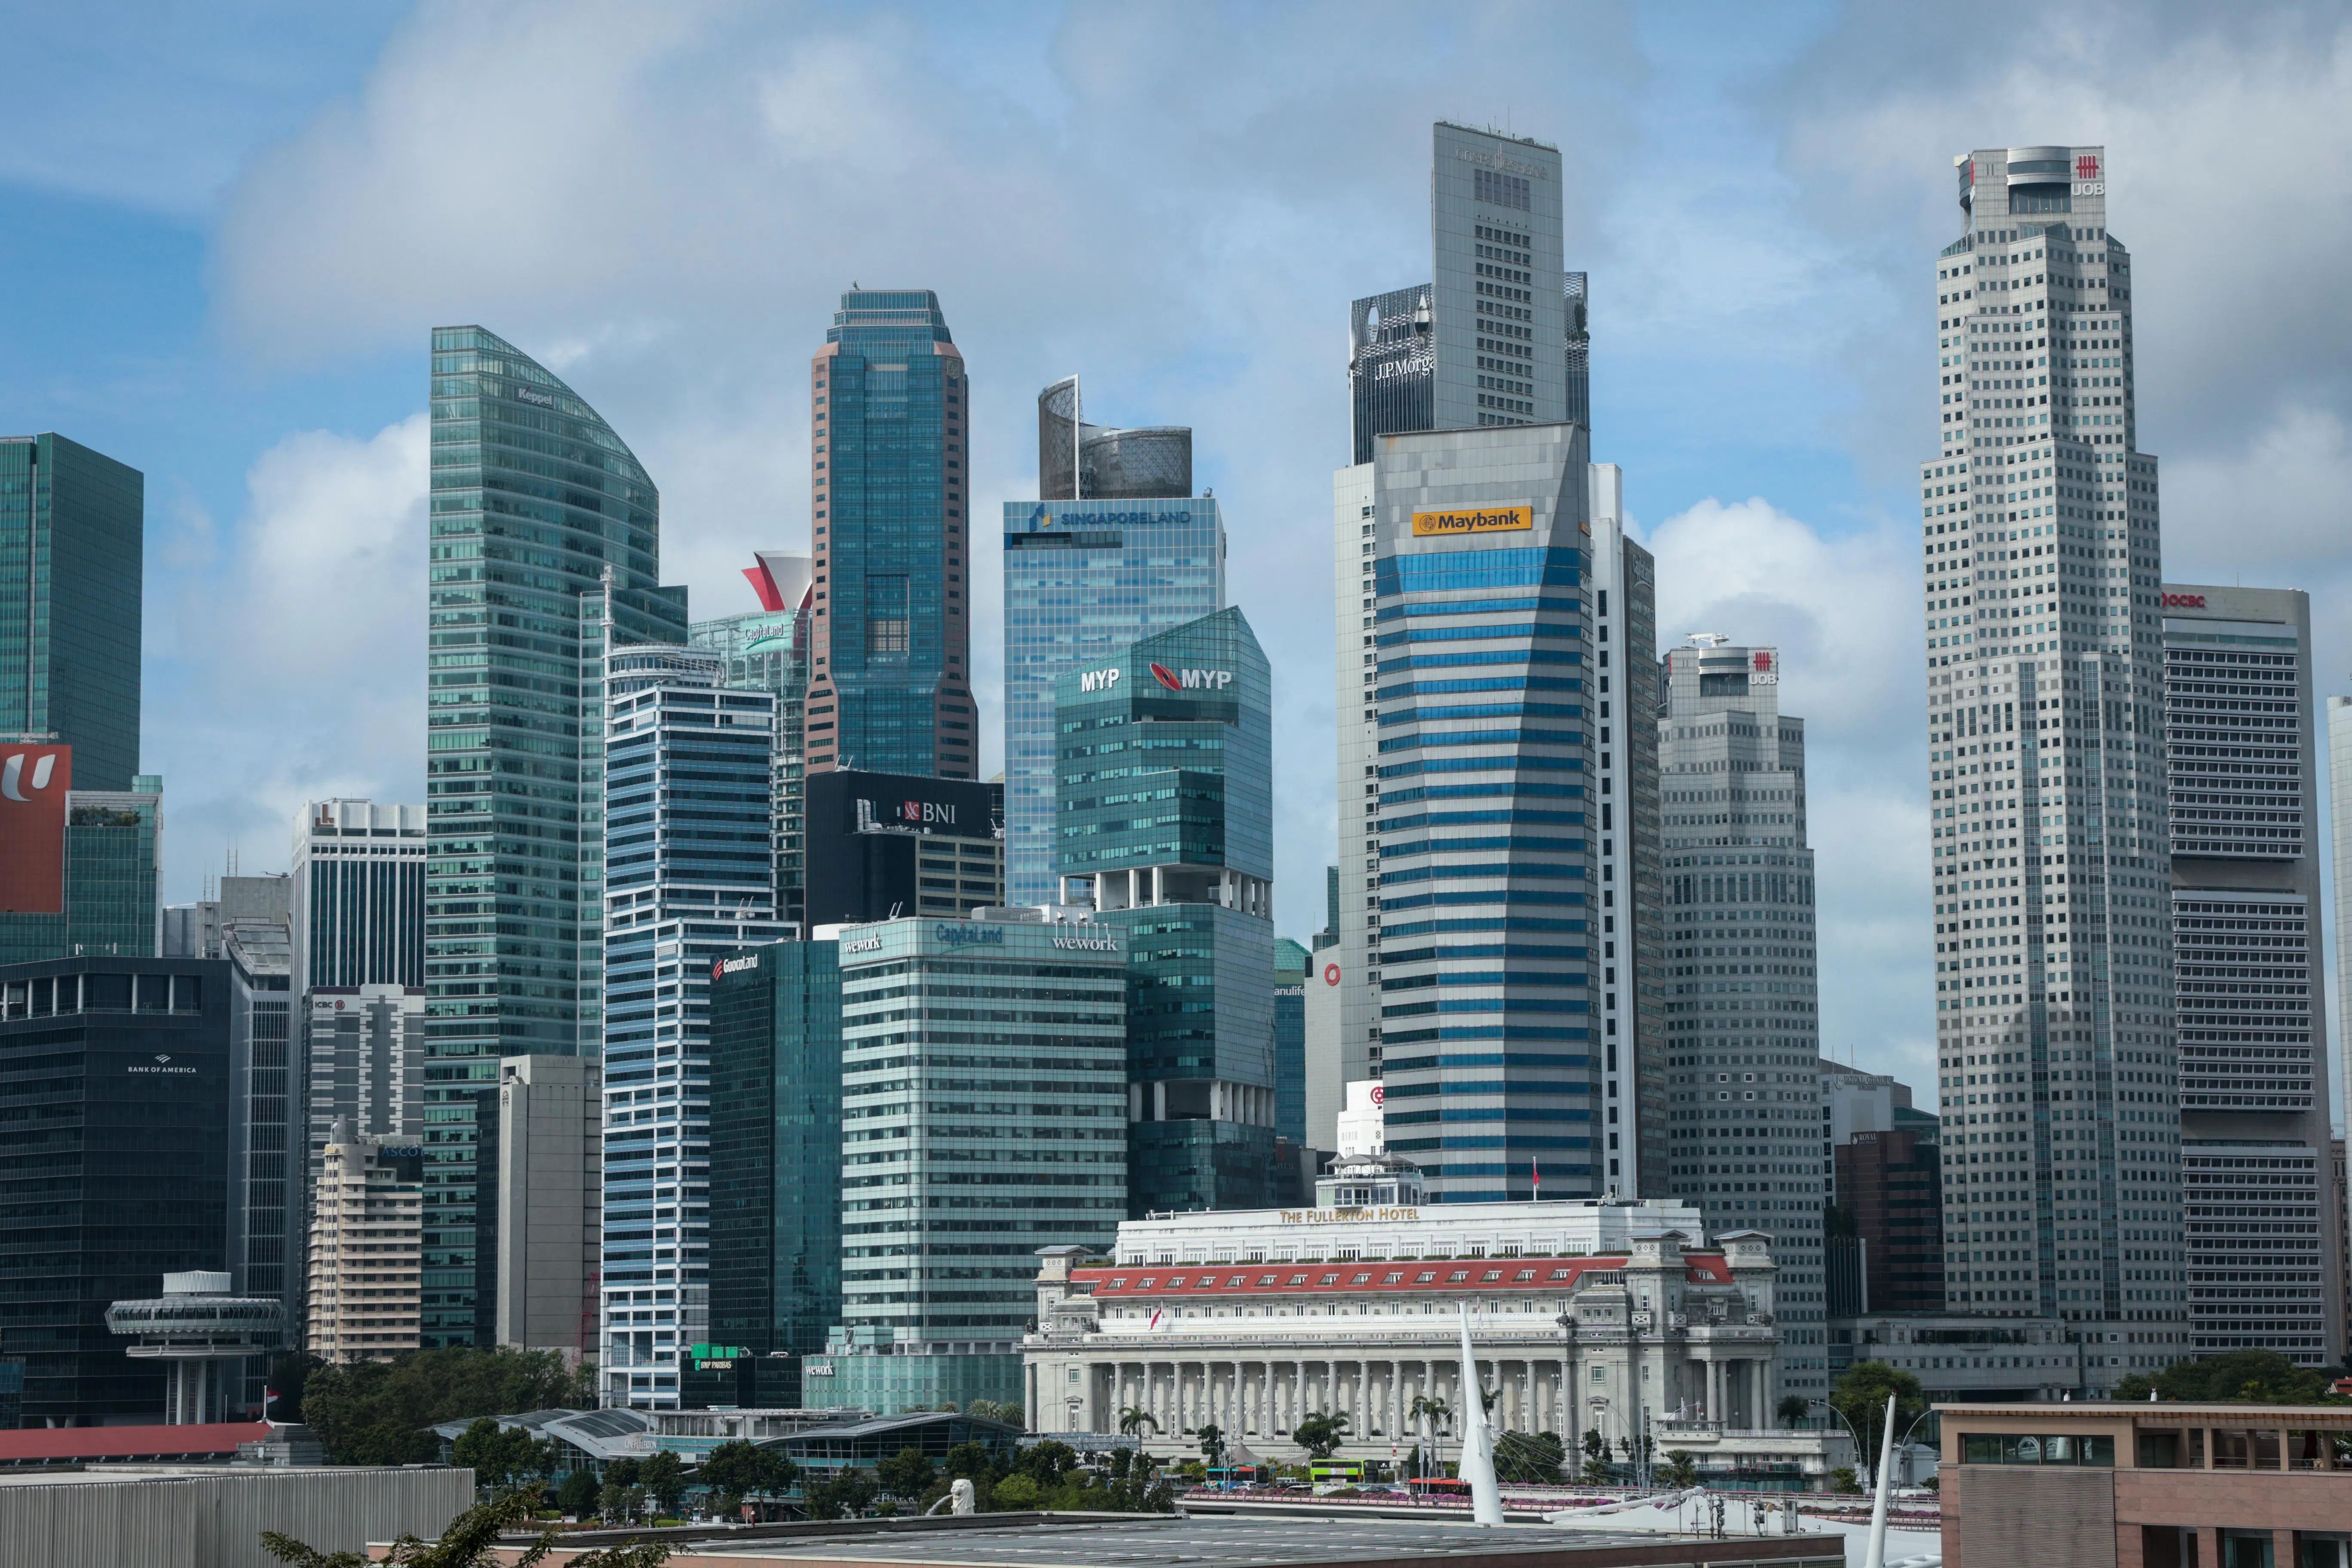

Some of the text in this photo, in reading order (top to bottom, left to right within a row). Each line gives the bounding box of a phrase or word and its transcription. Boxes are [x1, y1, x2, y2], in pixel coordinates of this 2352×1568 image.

[2071, 183, 2105, 196] UOB
[519, 386, 552, 405] Keppel
[1438, 510, 1520, 530] Maybank
[2168, 594, 2205, 607] OCBC
[745, 624, 783, 642] CapitaLand
[1081, 668, 1119, 692] MYP
[1182, 668, 1231, 689] MYP
[1749, 674, 1777, 685] UOB
[923, 802, 955, 824] BNI
[844, 931, 881, 953] wework
[936, 921, 1002, 946] CapitaLand
[1052, 934, 1118, 951] wework
[723, 953, 757, 973] GuocoLand
[1274, 985, 1305, 996] anulife
[1844, 1075, 1864, 1083] ROYAL
[1280, 1207, 1419, 1223] THE FULLERTON HOTEL
[805, 1360, 833, 1375] wework
